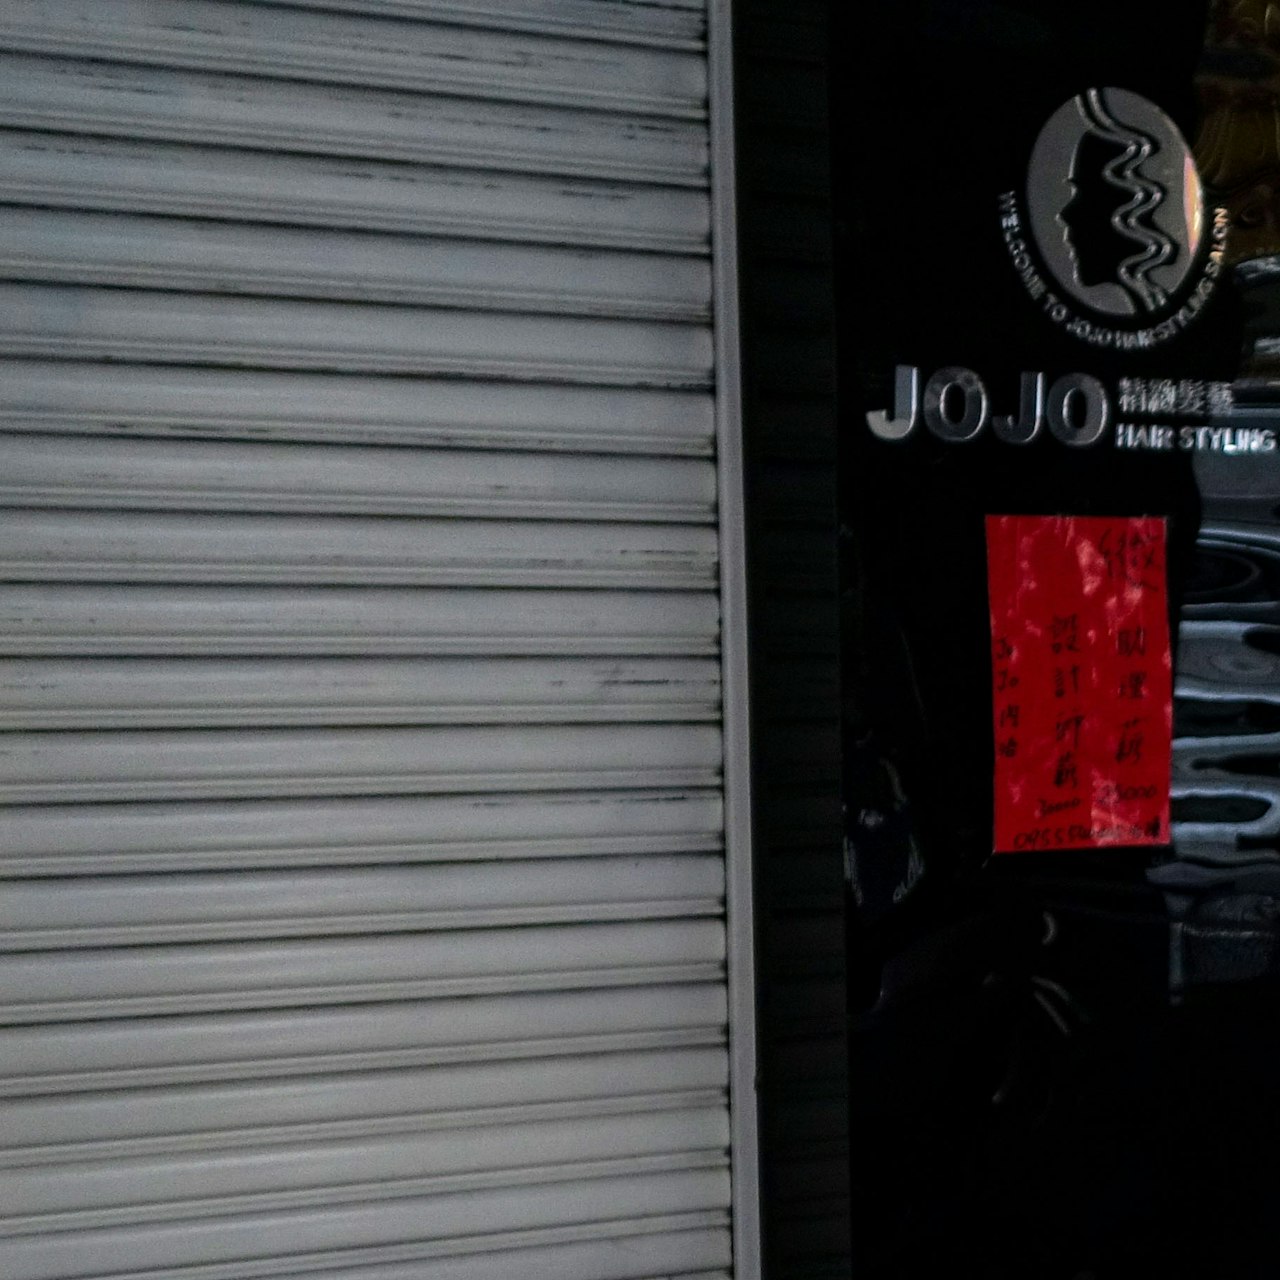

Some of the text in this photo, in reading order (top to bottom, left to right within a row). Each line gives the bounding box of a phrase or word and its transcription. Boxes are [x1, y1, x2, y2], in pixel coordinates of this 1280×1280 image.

[1043, 292, 1070, 323] TO
[865, 363, 1112, 448] JOJO
[1114, 422, 1175, 450] HAIR
[1178, 426, 1278, 455] STYLING
